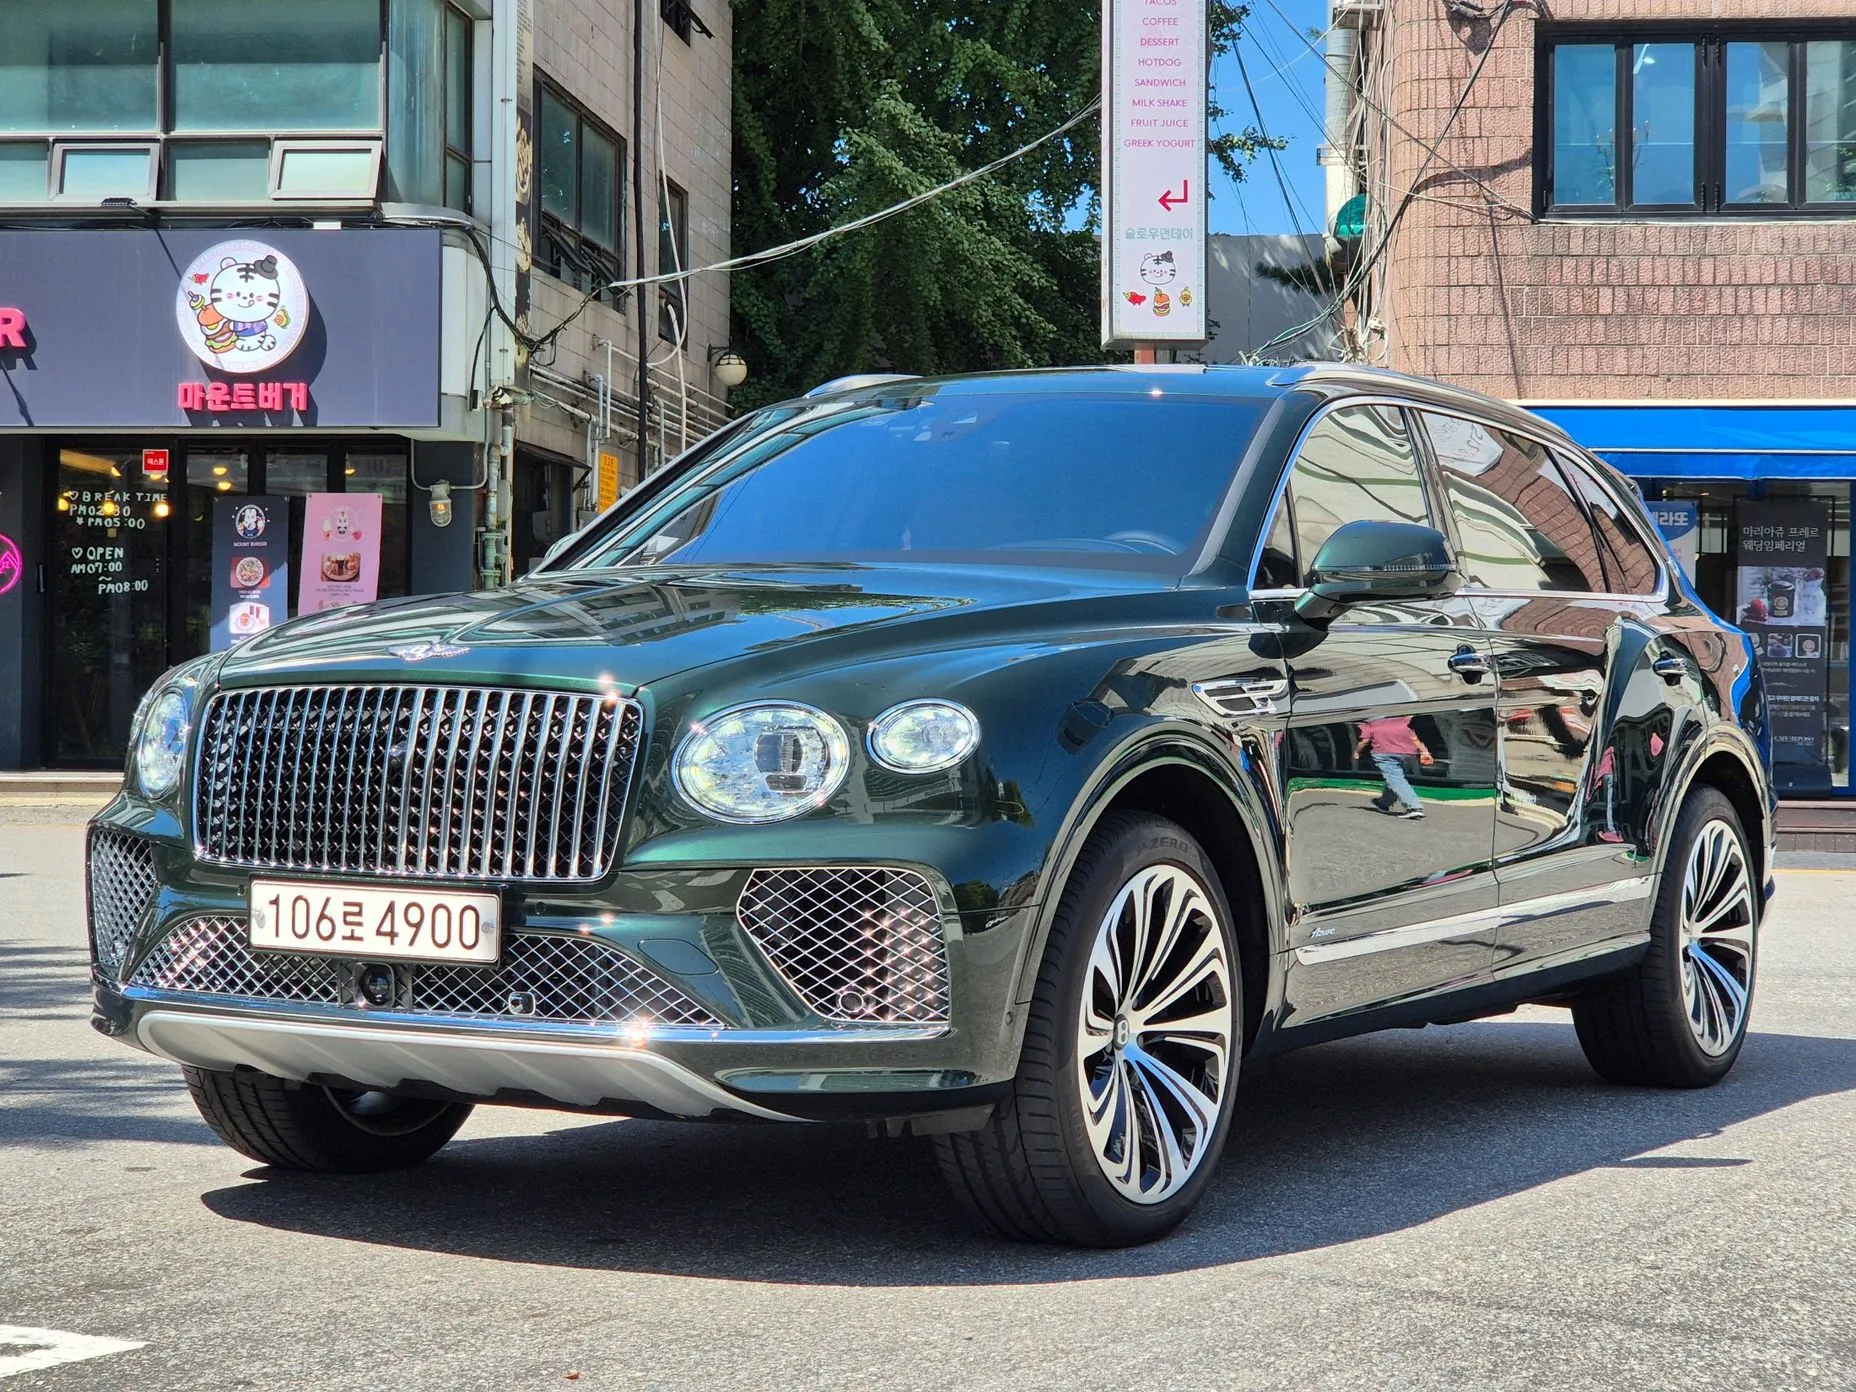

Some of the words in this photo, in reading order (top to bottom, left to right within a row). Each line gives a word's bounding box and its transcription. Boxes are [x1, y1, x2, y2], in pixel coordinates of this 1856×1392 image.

[1142, 17, 1179, 26] COFFEE
[1140, 38, 1179, 46] DESSERT
[1138, 58, 1182, 67] HOTDOG
[1134, 78, 1186, 87] SANDWICH
[1132, 99, 1155, 107] MILK
[1157, 99, 1188, 107] SHAKE
[1131, 119, 1157, 127] FRUIT
[1160, 119, 1189, 128] JUICE
[1124, 139, 1153, 147] GREEK
[1156, 139, 1195, 148] YOGURT
[178, 382, 307, 411] 마운트버거
[82, 491, 131, 502] BREAK
[136, 492, 167, 501] TIME
[87, 518, 146, 529] PM05:00
[1653, 511, 1689, 526] 라또
[1743, 526, 1785, 538] 마리아쥬
[1788, 526, 1819, 538] 프레르
[1743, 540, 1806, 552] 웨딩임페리얼
[87, 547, 124, 560] OPEN
[71, 562, 122, 574] AM07:00
[98, 580, 148, 594] PM08:00
[1150, 837, 1189, 852] ZERO
[268, 893, 365, 942] 106로
[375, 900, 481, 950] 4900
